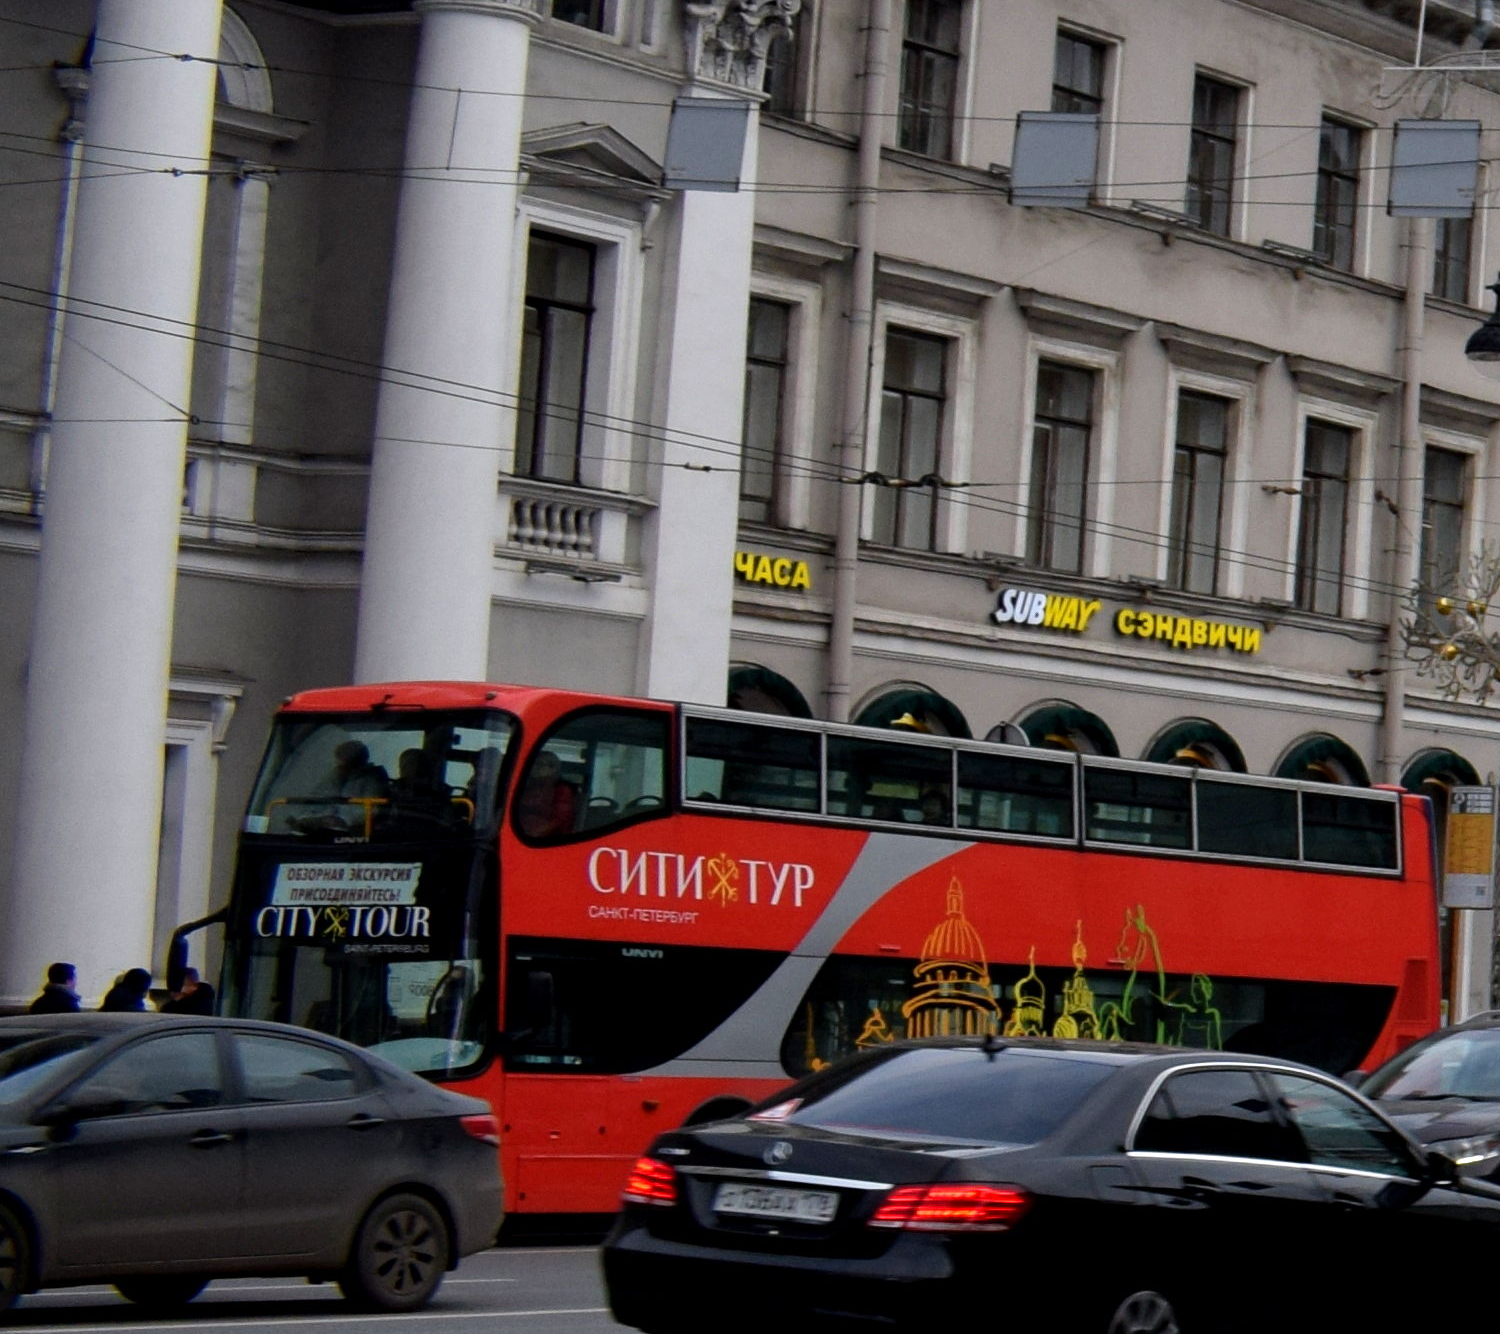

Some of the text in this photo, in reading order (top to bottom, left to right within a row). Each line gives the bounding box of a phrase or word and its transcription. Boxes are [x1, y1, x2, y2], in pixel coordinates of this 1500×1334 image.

[735, 551, 811, 589] ЧАСА
[996, 589, 1102, 632] SUBWAY
[286, 868, 412, 881] ОБЗОРНАЯ ЭКСКУРСИЯ
[588, 847, 815, 907] СИТИ ТУР
[256, 906, 431, 937] CITY TOUR
[588, 905, 699, 924] САНКТ-ПЕТЕРБУРГ
